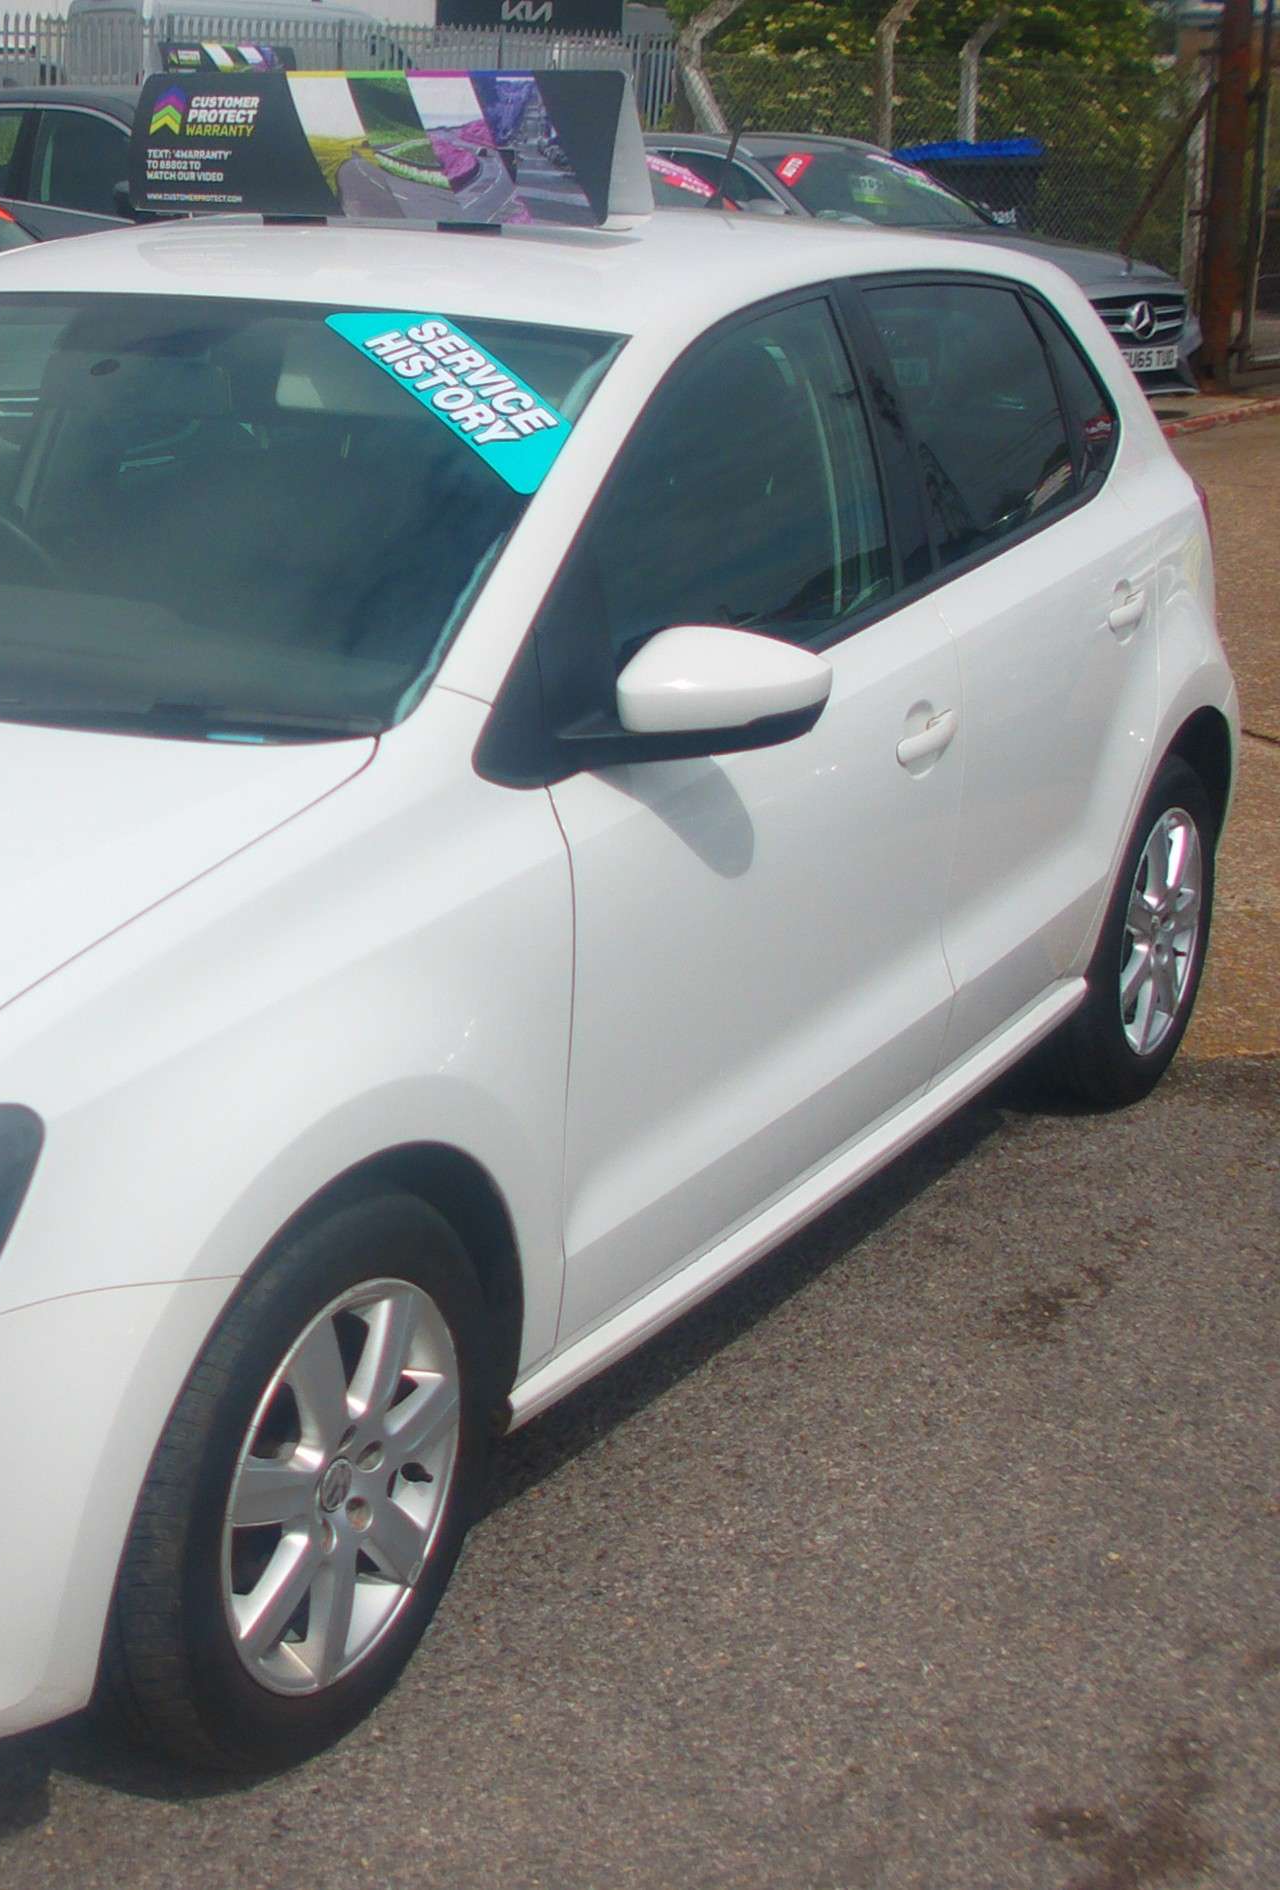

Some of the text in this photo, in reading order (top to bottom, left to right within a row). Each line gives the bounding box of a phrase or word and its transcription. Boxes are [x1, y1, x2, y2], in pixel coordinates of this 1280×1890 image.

[191, 96, 260, 108] CUSTOMER
[187, 109, 258, 123] PROTECT
[185, 124, 255, 136] WARRANTY
[146, 160, 158, 169] TO
[189, 161, 201, 170] TO
[146, 170, 224, 182] WATCH OUR VIDEO
[407, 320, 560, 435] SERVICE
[362, 331, 521, 445] HISTORY
